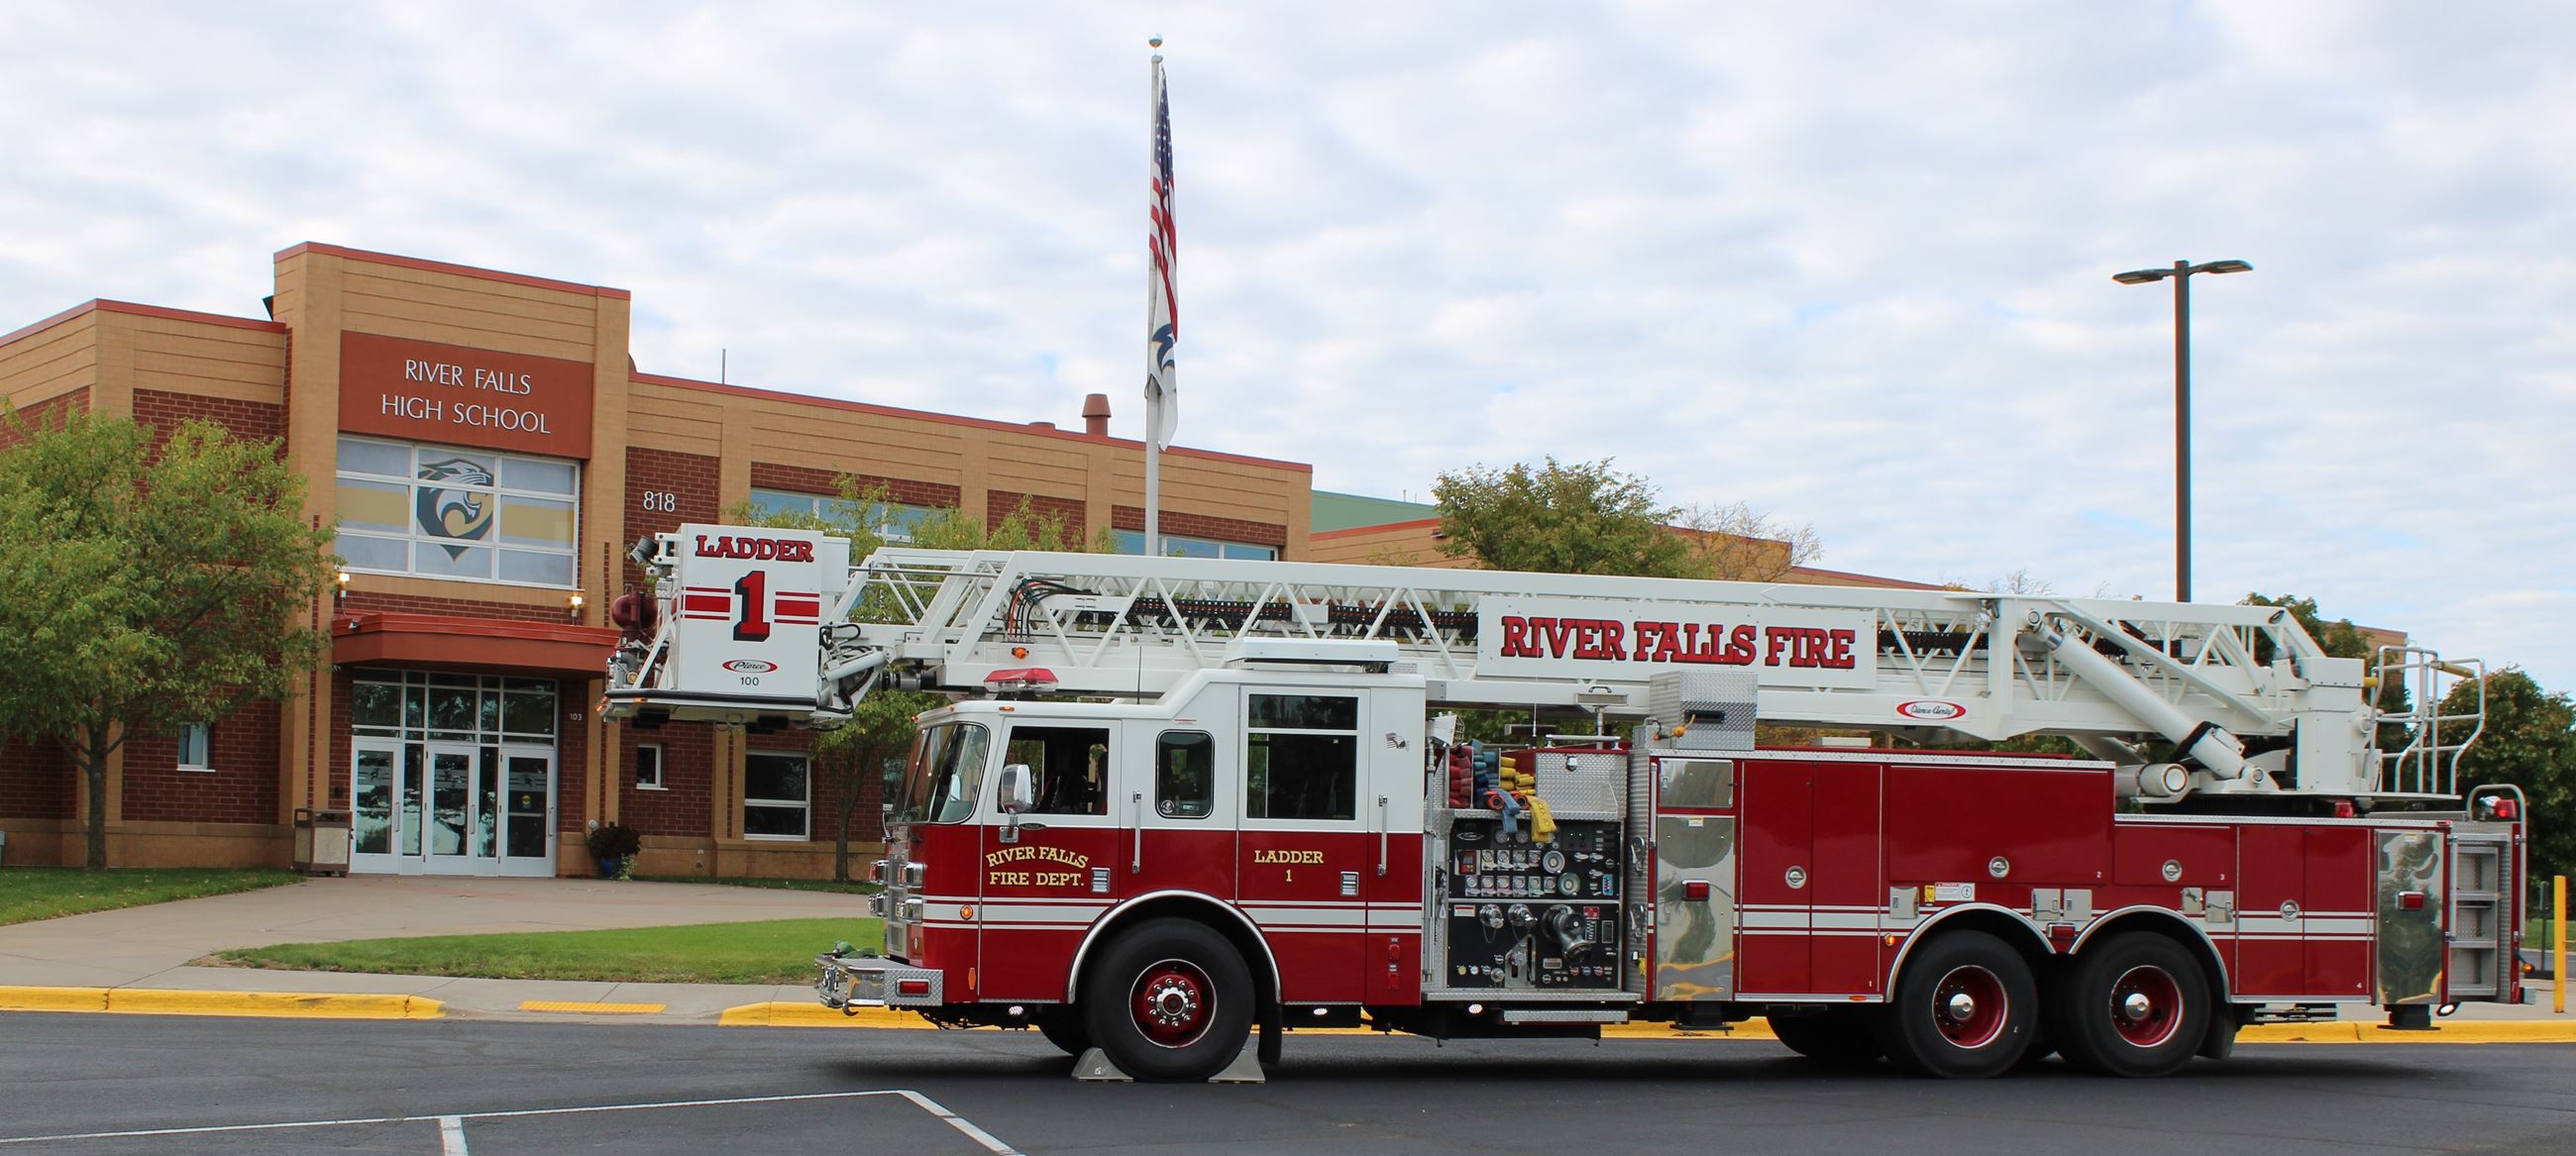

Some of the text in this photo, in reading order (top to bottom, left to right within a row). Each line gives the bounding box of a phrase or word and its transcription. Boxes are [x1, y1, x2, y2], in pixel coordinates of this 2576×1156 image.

[404, 359, 531, 395] RIVER FALLS
[381, 394, 551, 435] HIGH SCHOOL
[643, 490, 676, 513] 818
[696, 535, 814, 563] LADDER
[733, 570, 770, 641] 1
[1500, 615, 1856, 670] RIVER FALLS FIRE
[740, 677, 760, 686] 100
[570, 712, 583, 721] 103
[986, 846, 1089, 869] RIVER FALLS
[1254, 850, 1324, 864] LADDER
[990, 872, 1085, 887] FIRE DEPT.
[1285, 869, 1292, 883] 1
